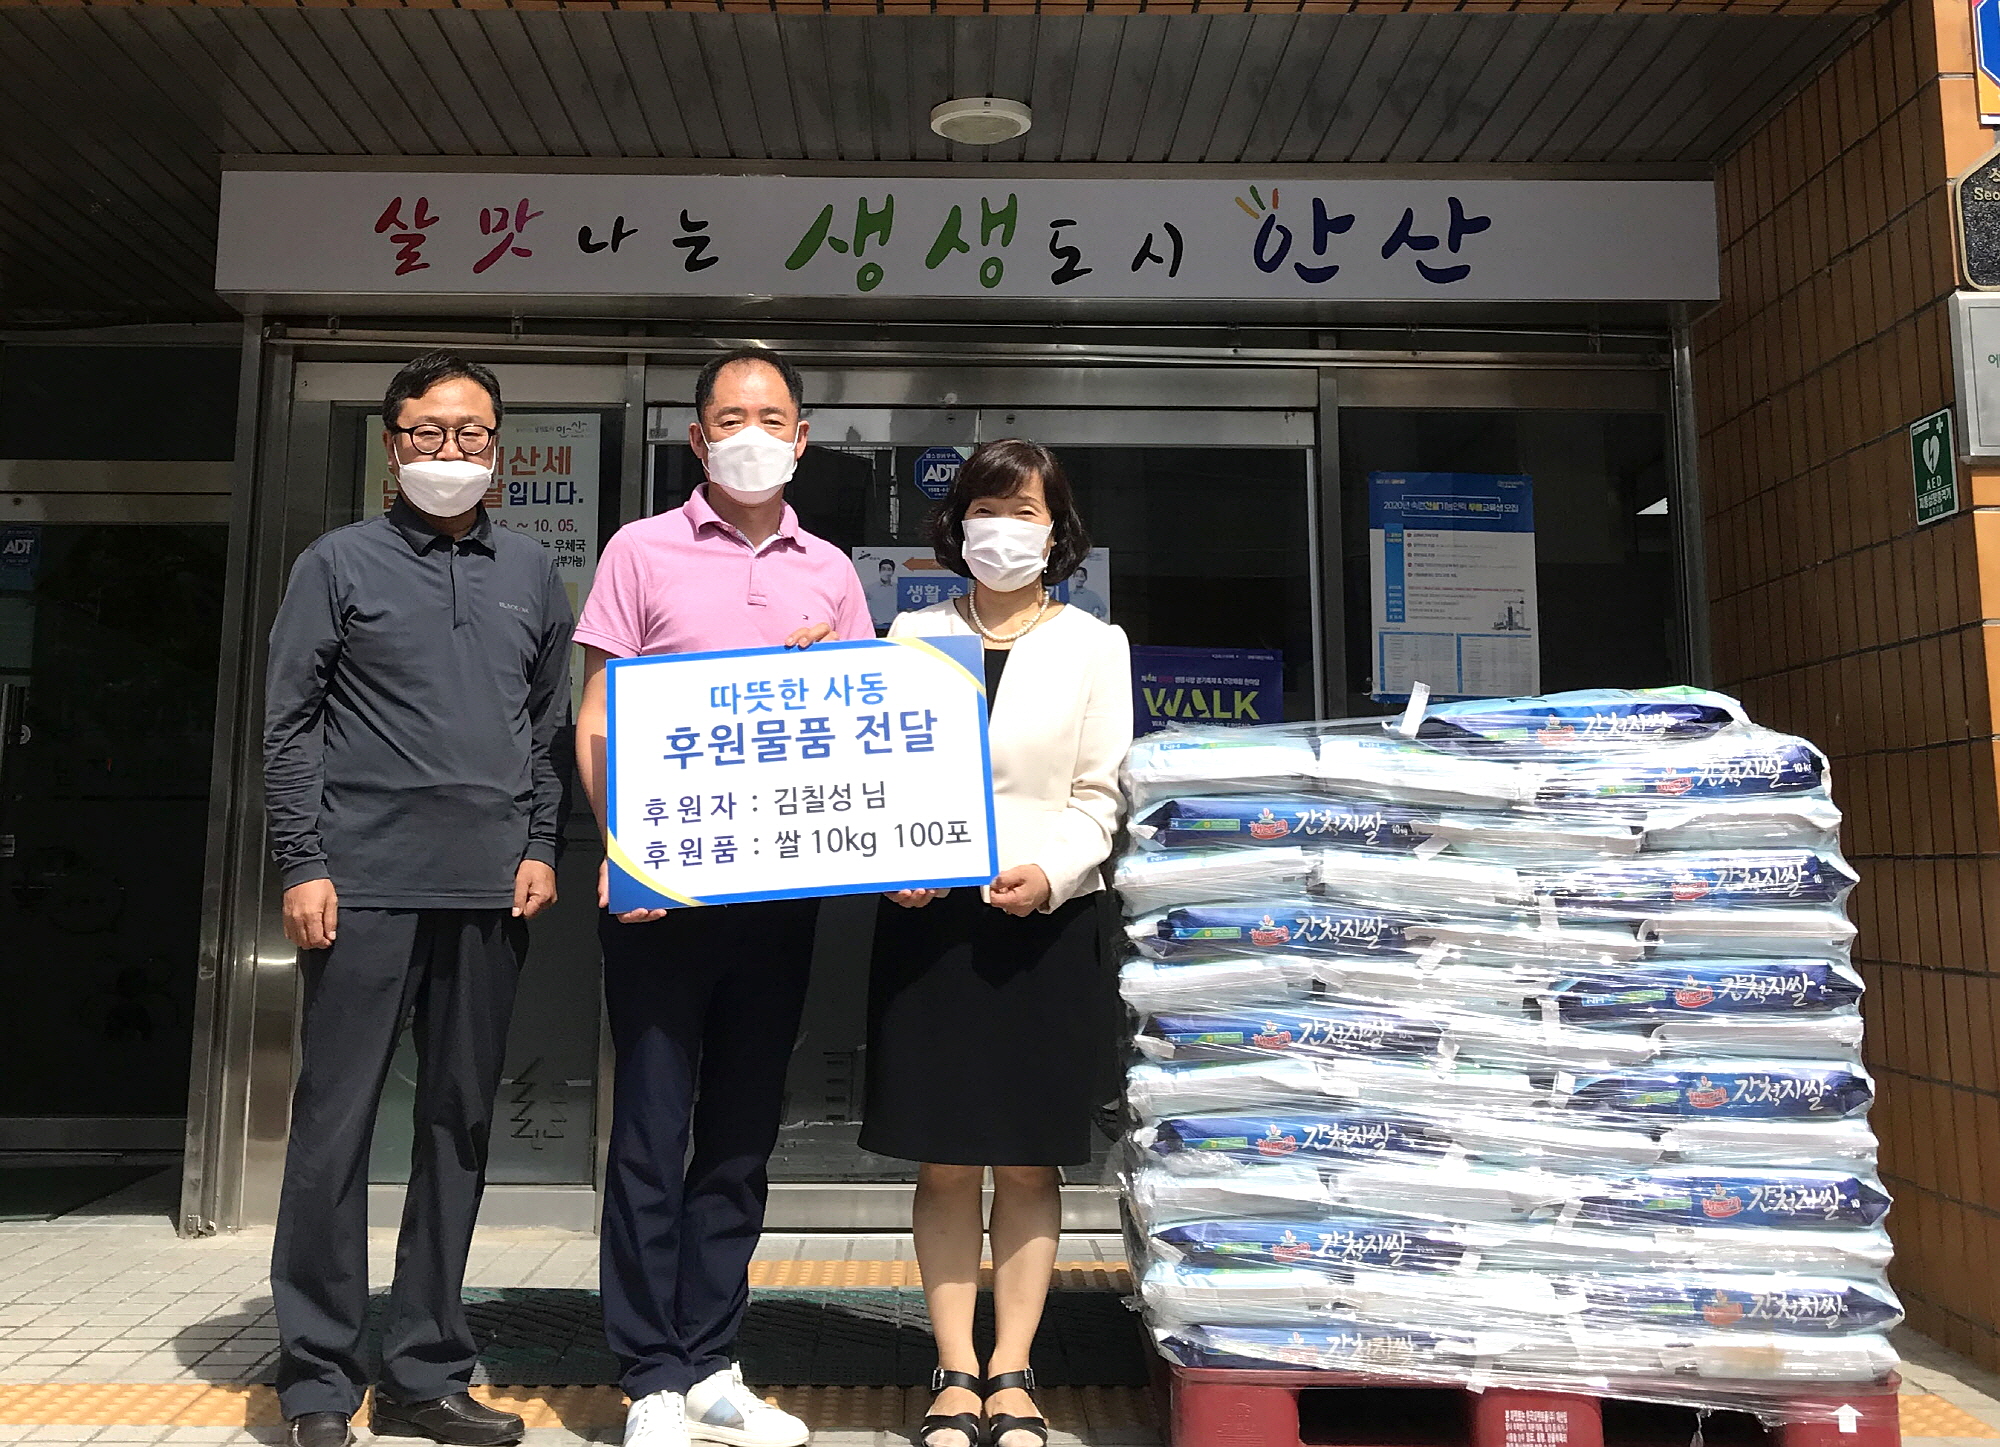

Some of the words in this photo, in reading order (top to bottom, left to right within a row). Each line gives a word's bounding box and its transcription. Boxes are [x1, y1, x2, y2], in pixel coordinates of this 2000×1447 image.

[1252, 196, 1492, 284] 안산
[922, 464, 960, 483] ADT
[1926, 475, 1942, 491] AED
[558, 519, 578, 532] 05.
[3, 539, 35, 554] ADT
[554, 539, 586, 552] 우체국
[907, 585, 942, 603] 생활
[710, 677, 810, 715] 따뜻한
[823, 671, 888, 708] 사동
[1142, 687, 1260, 720] WALK
[662, 716, 836, 770] 후원물품
[855, 708, 939, 755] 전달
[773, 783, 853, 816] 김칠성
[862, 780, 887, 811] 님
[774, 831, 801, 860] 쌀
[811, 826, 878, 858] 10kg
[893, 819, 973, 849] 100포
[1292, 809, 1388, 845] 간척지쌀
[1292, 915, 1389, 950] 간척지쌀
[1732, 1075, 1832, 1112] 간척지쌀
[1746, 1183, 1848, 1221] 간척지쌀
